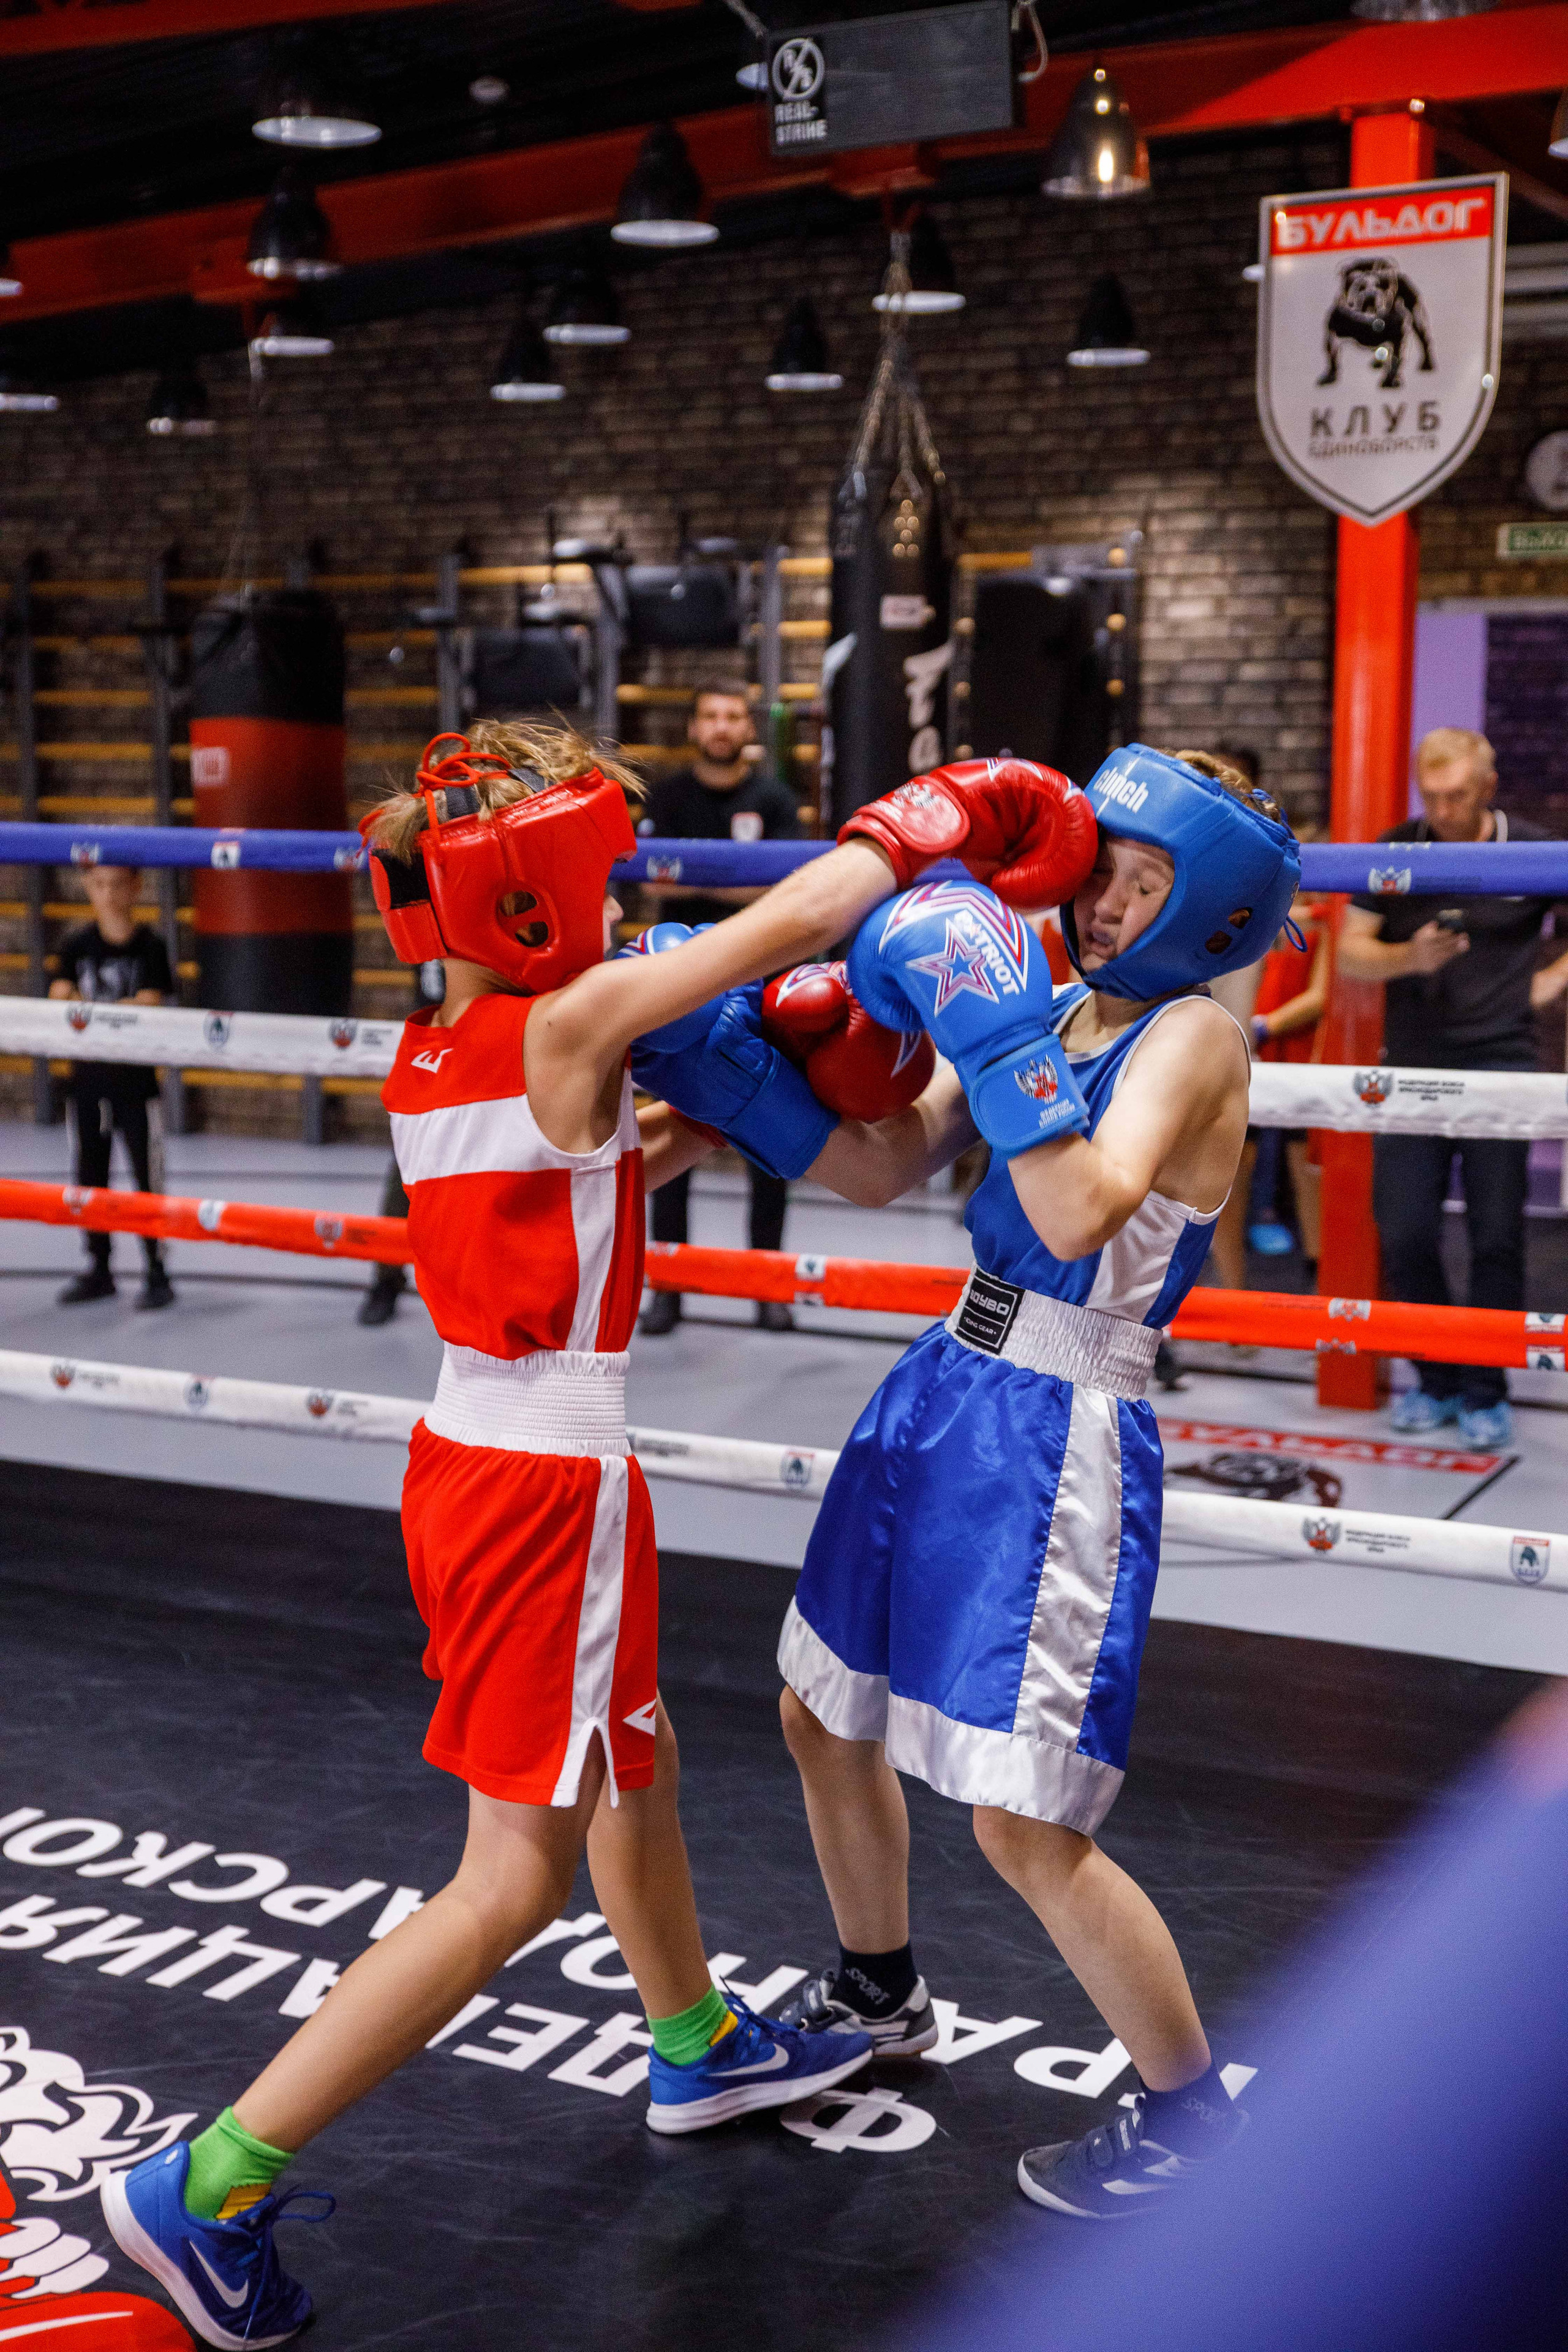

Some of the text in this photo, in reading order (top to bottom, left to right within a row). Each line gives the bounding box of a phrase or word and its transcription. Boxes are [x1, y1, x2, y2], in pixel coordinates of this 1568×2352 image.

[1276, 197, 1486, 248] БУЛЬДОГ
[1310, 401, 1441, 438] КЛУБ
[1093, 766, 1149, 814] clinch
[1180, 2097, 1227, 2125] SPO
